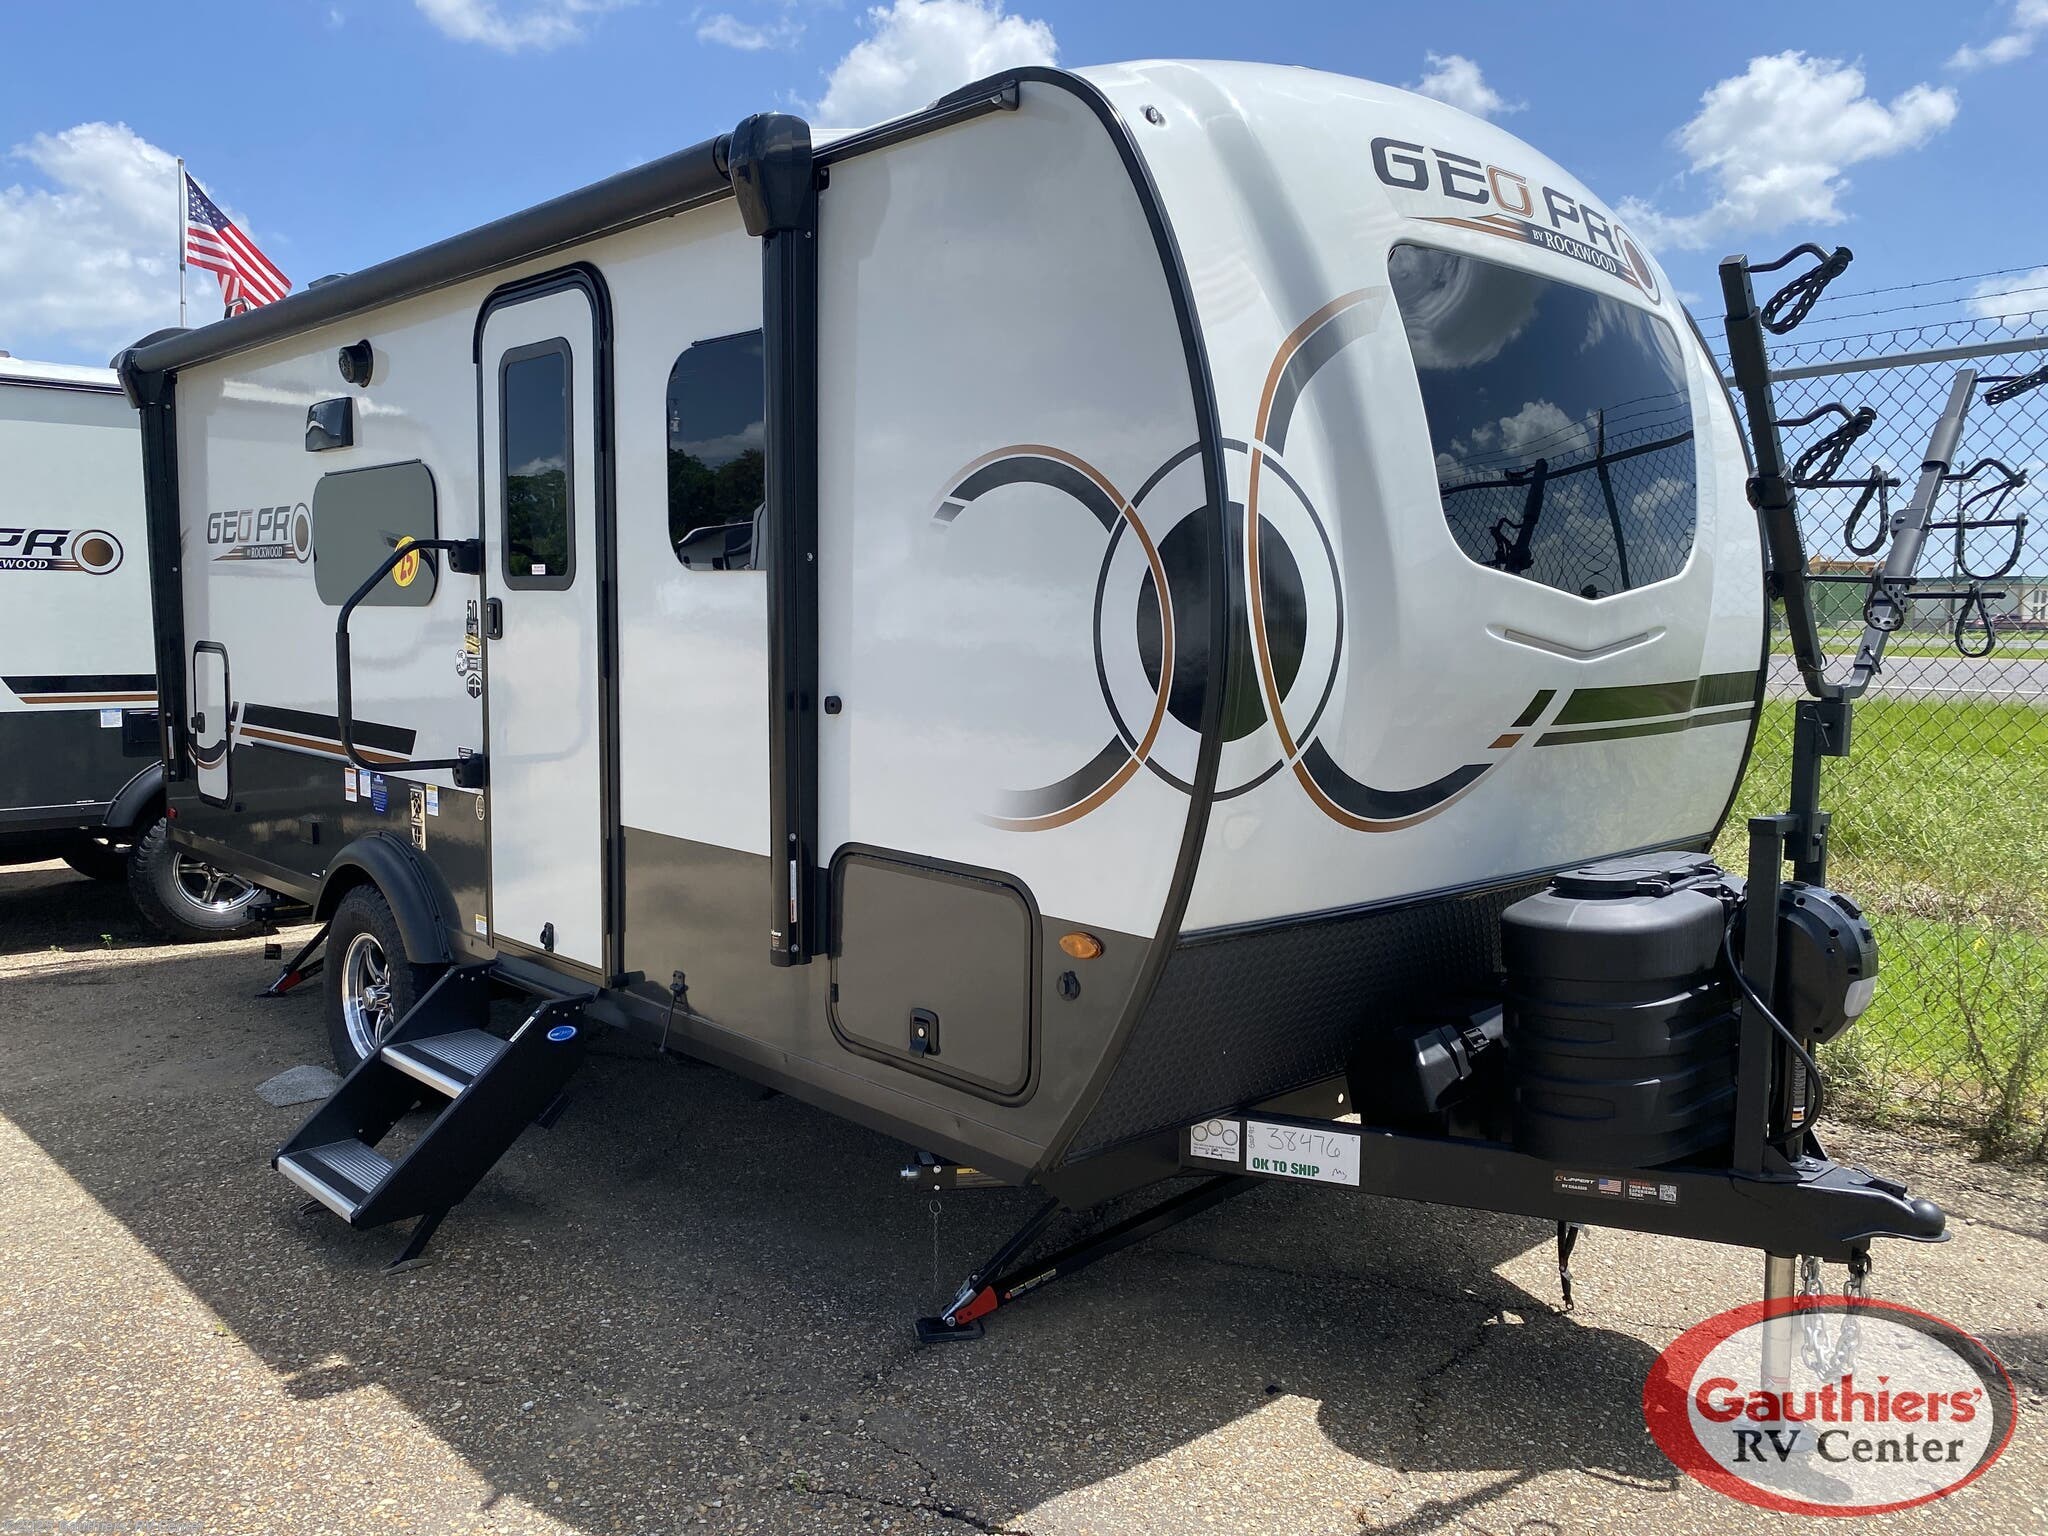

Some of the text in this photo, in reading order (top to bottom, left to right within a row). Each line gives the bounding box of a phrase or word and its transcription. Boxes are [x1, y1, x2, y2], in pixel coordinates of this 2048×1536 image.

[1371, 137, 1661, 306] GEO PRO
[1532, 230, 1617, 273] BY ROCKWOOD
[207, 502, 314, 564] GEO PRO
[251, 546, 283, 558] ROCKWOOD
[1266, 1127, 1341, 1158] 38476
[1252, 1157, 1320, 1177] OK TO SHIP
